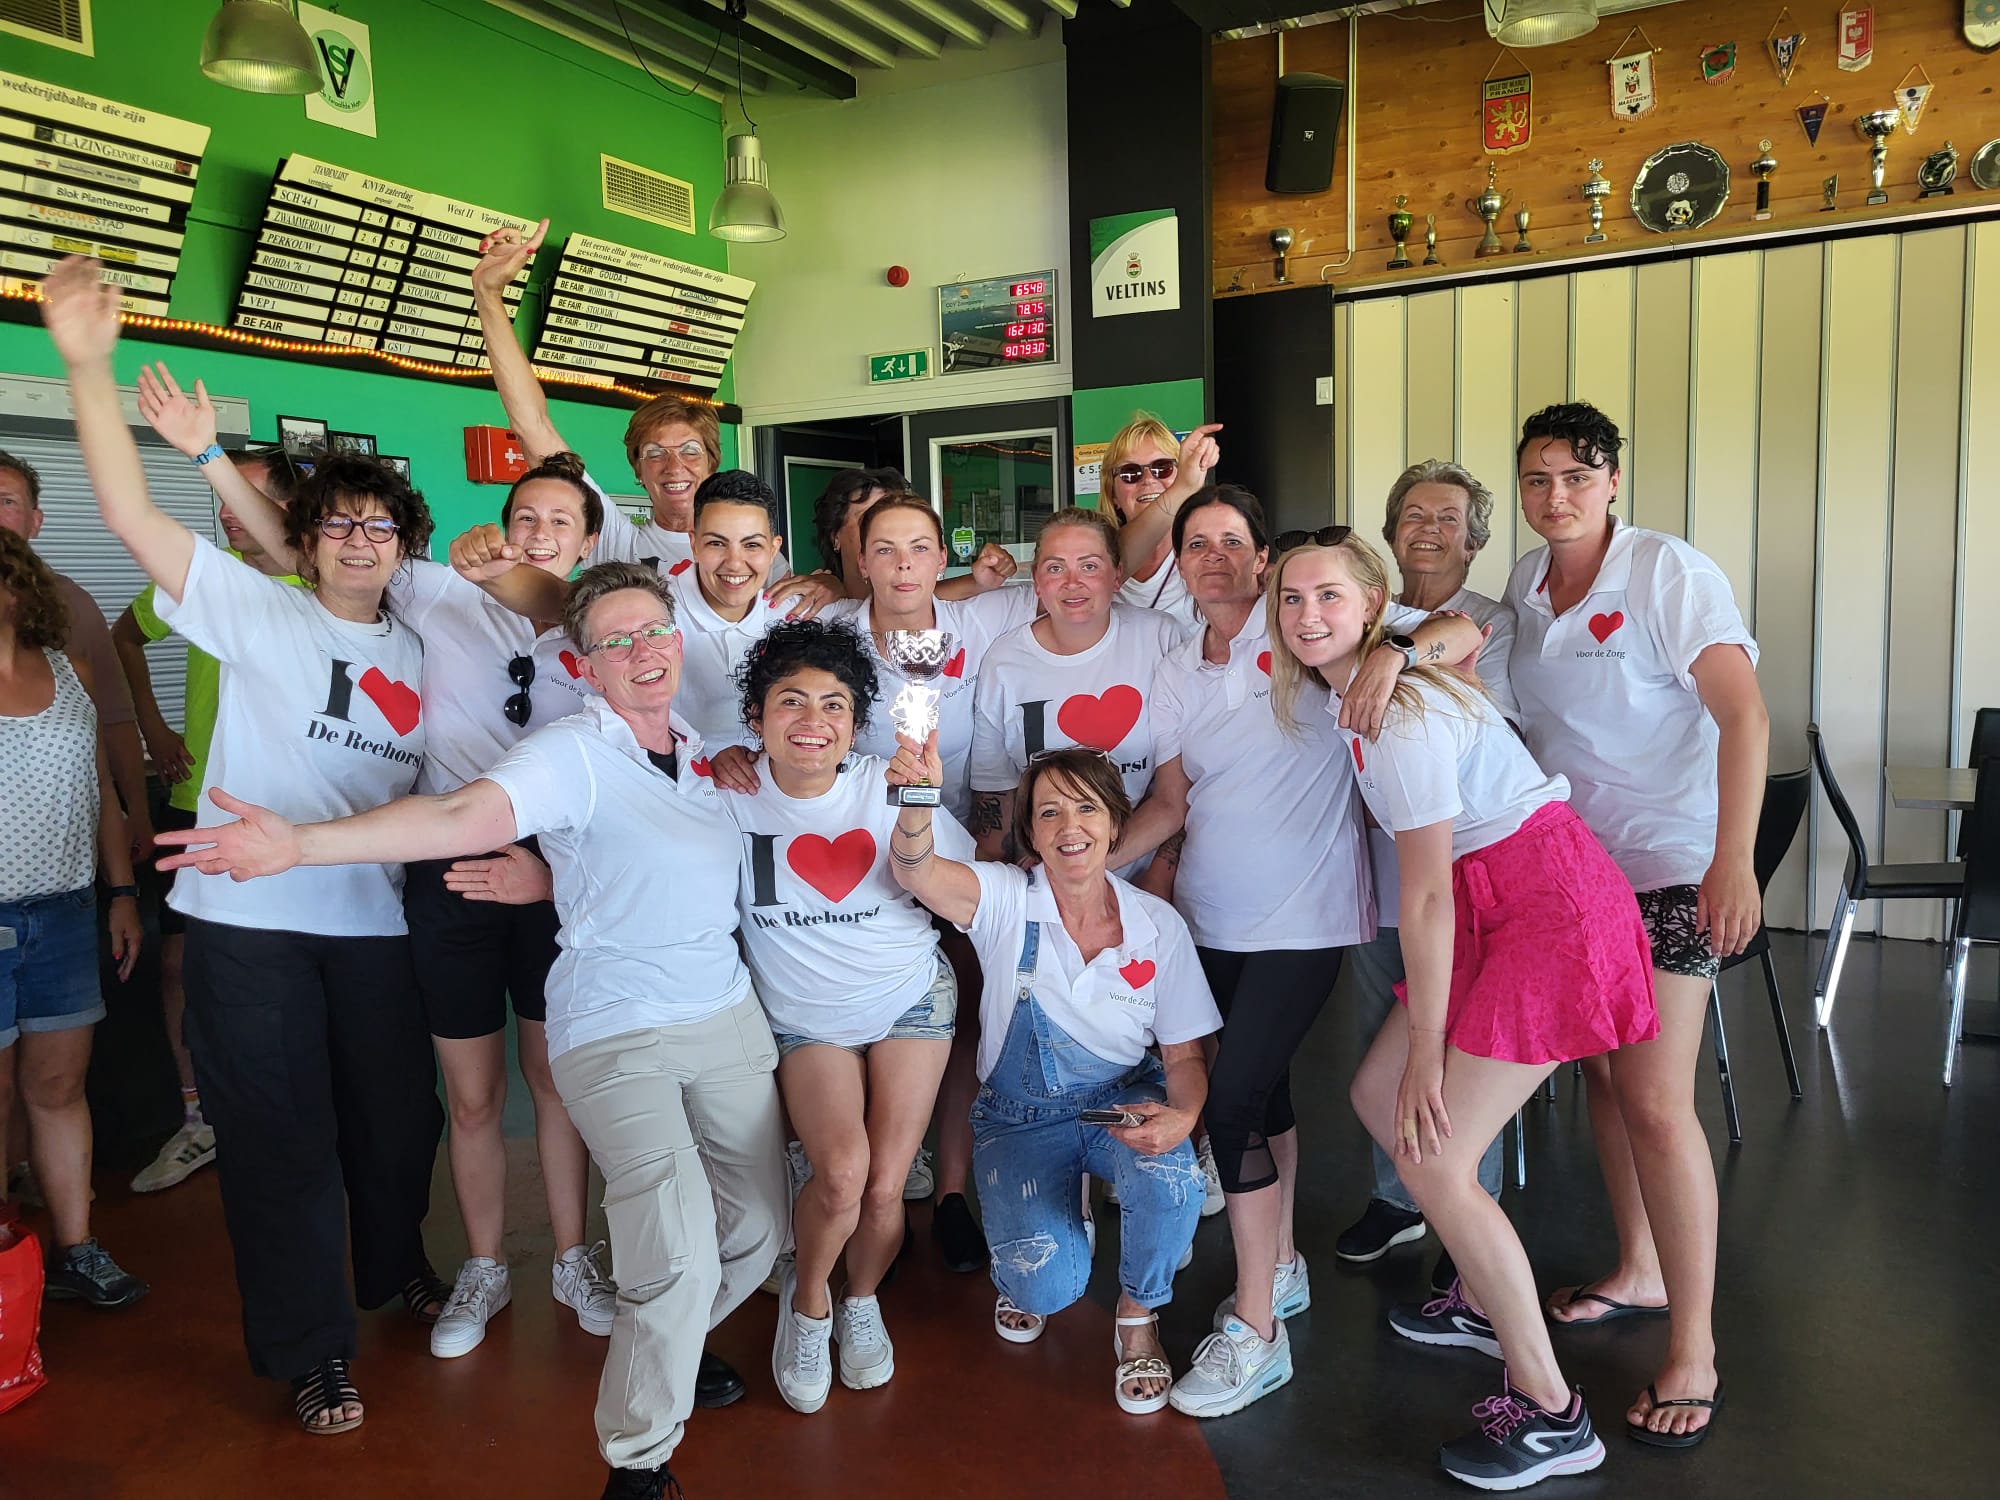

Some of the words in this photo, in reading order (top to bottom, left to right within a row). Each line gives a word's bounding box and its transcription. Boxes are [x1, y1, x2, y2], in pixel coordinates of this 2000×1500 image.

[1622, 60, 1641, 70] MVV
[1490, 86, 1526, 97] FRANCE
[102, 104, 121, 118] die
[122, 110, 147, 125] zijn
[52, 130, 112, 157] CLAZING
[57, 186, 80, 200] Blok
[81, 193, 150, 215] Plantenexport
[362, 178, 386, 194] KNVB
[385, 186, 414, 203] zaterdag
[447, 203, 466, 217] West
[480, 212, 501, 227] Vierde
[521, 223, 528, 232] B
[274, 211, 331, 235] ZWAMMERDAM
[266, 233, 316, 251] PERKOUW
[580, 238, 593, 248] Het
[592, 241, 611, 254] eerste
[611, 246, 628, 258] elftal
[262, 254, 292, 271] ROHDA
[419, 247, 446, 262] GOUDA
[576, 248, 622, 265] geschonken
[412, 266, 442, 280] CABAUW
[569, 262, 579, 273] BE
[599, 270, 623, 283] GOUDA
[253, 273, 305, 294] LINSCHOTEN
[560, 279, 569, 290] BE
[1106, 280, 1166, 301] VELTINS
[250, 295, 270, 308] VEP
[406, 285, 441, 301] STOLWIJK
[400, 304, 418, 316] WDS
[557, 298, 566, 308] BE
[242, 315, 257, 328] BE
[258, 318, 284, 333] FAIR
[555, 315, 564, 325] BE
[584, 321, 599, 332] VEP
[549, 333, 558, 343] BE
[386, 342, 405, 353] GSV
[541, 350, 550, 360] BE
[1575, 650, 1594, 659] Voor
[1594, 649, 1605, 658] de
[1606, 649, 1626, 660] Zorg
[314, 658, 358, 724] I
[550, 675, 568, 689] Voor
[568, 682, 578, 693] de
[1015, 699, 1054, 768] I
[306, 719, 340, 744] De
[343, 729, 422, 769] Reehors
[742, 831, 788, 907] I
[751, 912, 781, 929] De
[784, 904, 880, 928] Reehorst
[1109, 991, 1127, 1002] Voor
[1127, 995, 1137, 1005] de
[1137, 997, 1156, 1010] Zorg
